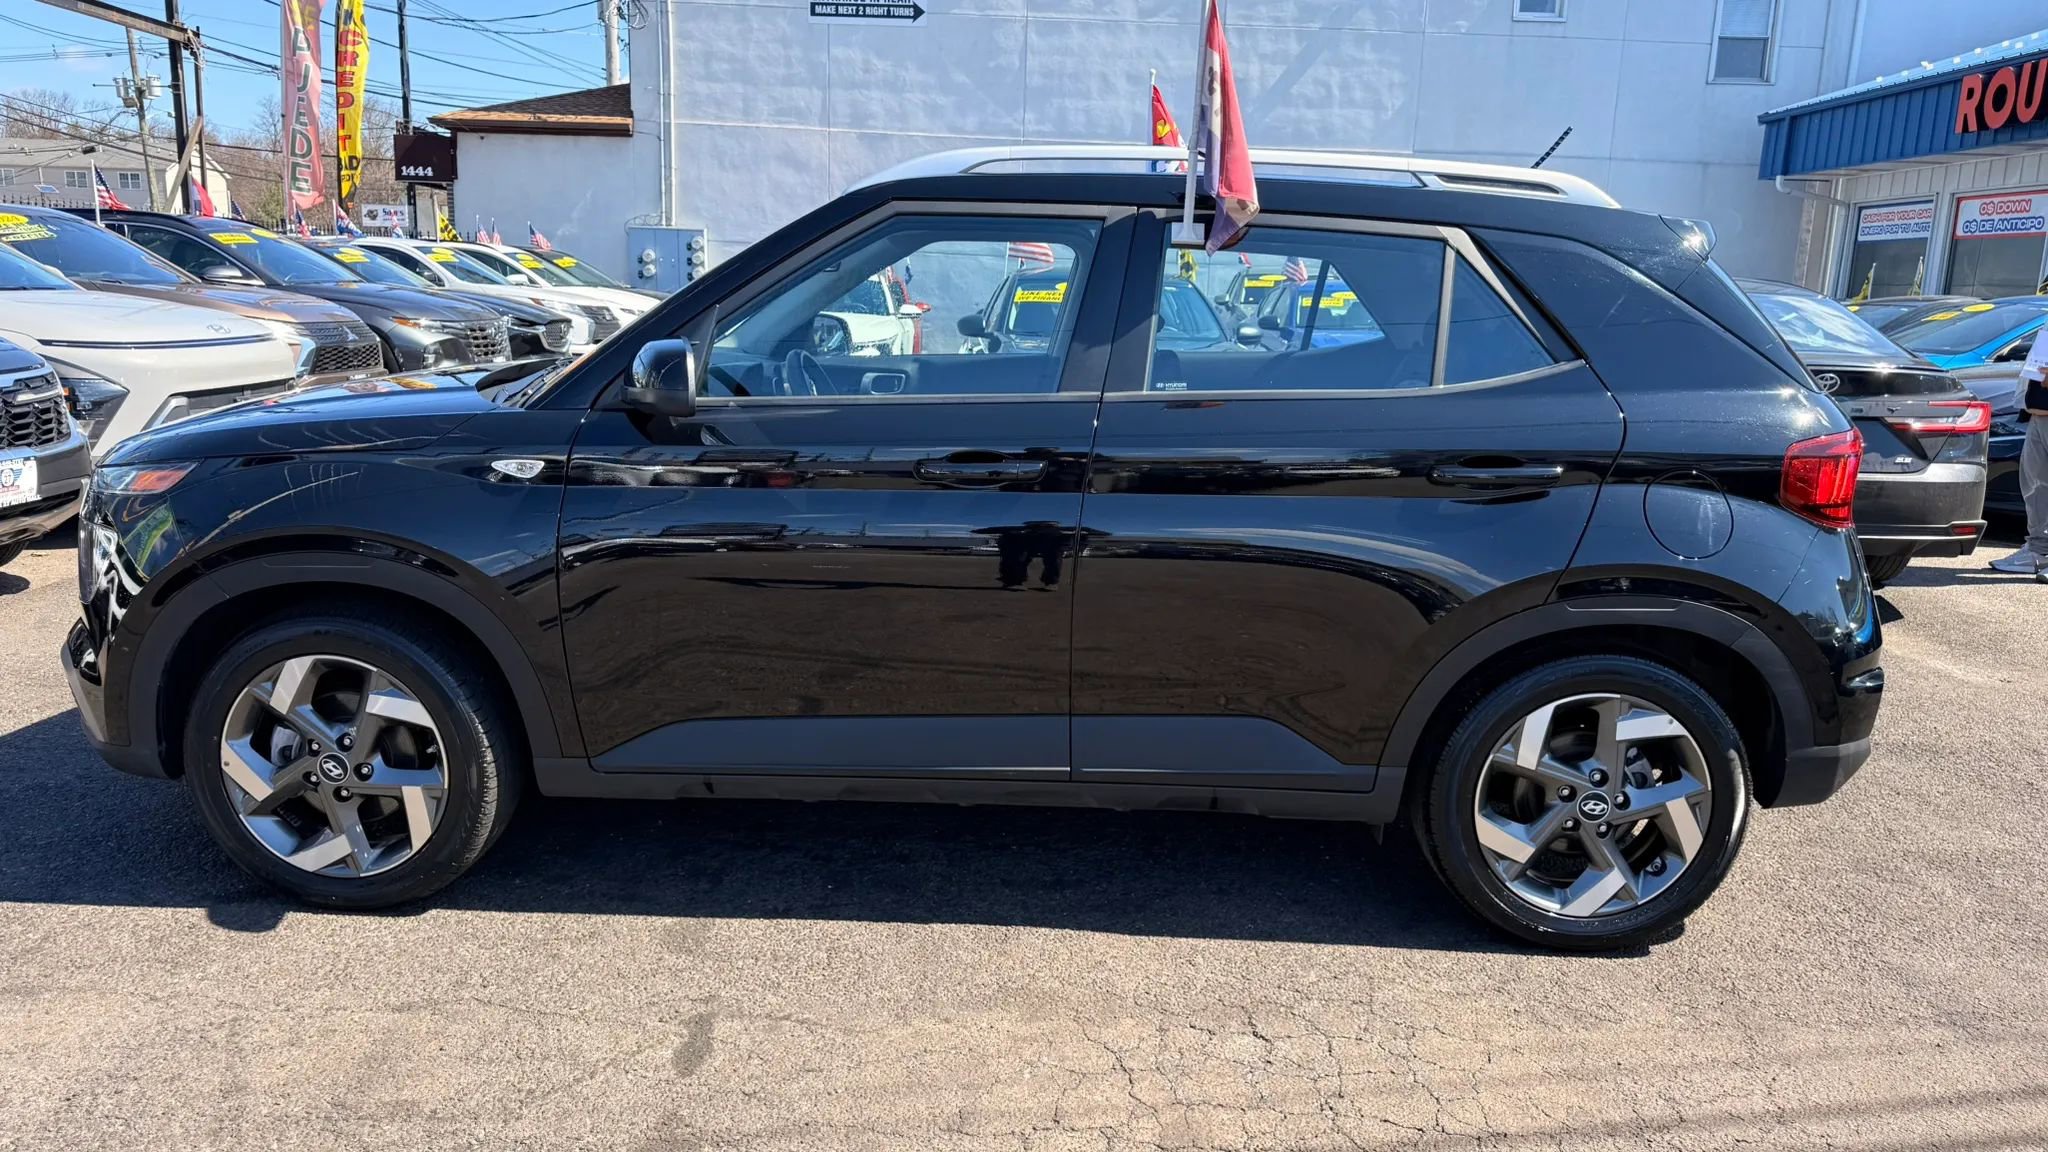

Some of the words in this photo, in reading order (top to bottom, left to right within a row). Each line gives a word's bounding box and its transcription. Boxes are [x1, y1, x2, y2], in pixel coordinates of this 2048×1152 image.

[815, 4, 836, 14] MAKE
[838, 6, 857, 15] NEXT
[858, 7, 864, 15] 2
[865, 7, 888, 16] RIGHT
[889, 7, 914, 16] TURNS
[337, 30, 362, 152] CREDIT
[1954, 58, 2048, 134] ROU
[400, 165, 434, 177] 1444
[1996, 199, 2032, 214] DOWN
[1862, 213, 1881, 224] CASH
[1881, 212, 1896, 222] FOR
[1896, 210, 1916, 221] YOUR
[1860, 225, 1884, 236] DINERO
[1884, 224, 1899, 235] POR
[1900, 223, 1911, 234] TU
[1979, 218, 1993, 233] DE
[1995, 216, 2045, 233] ANTICIPO
